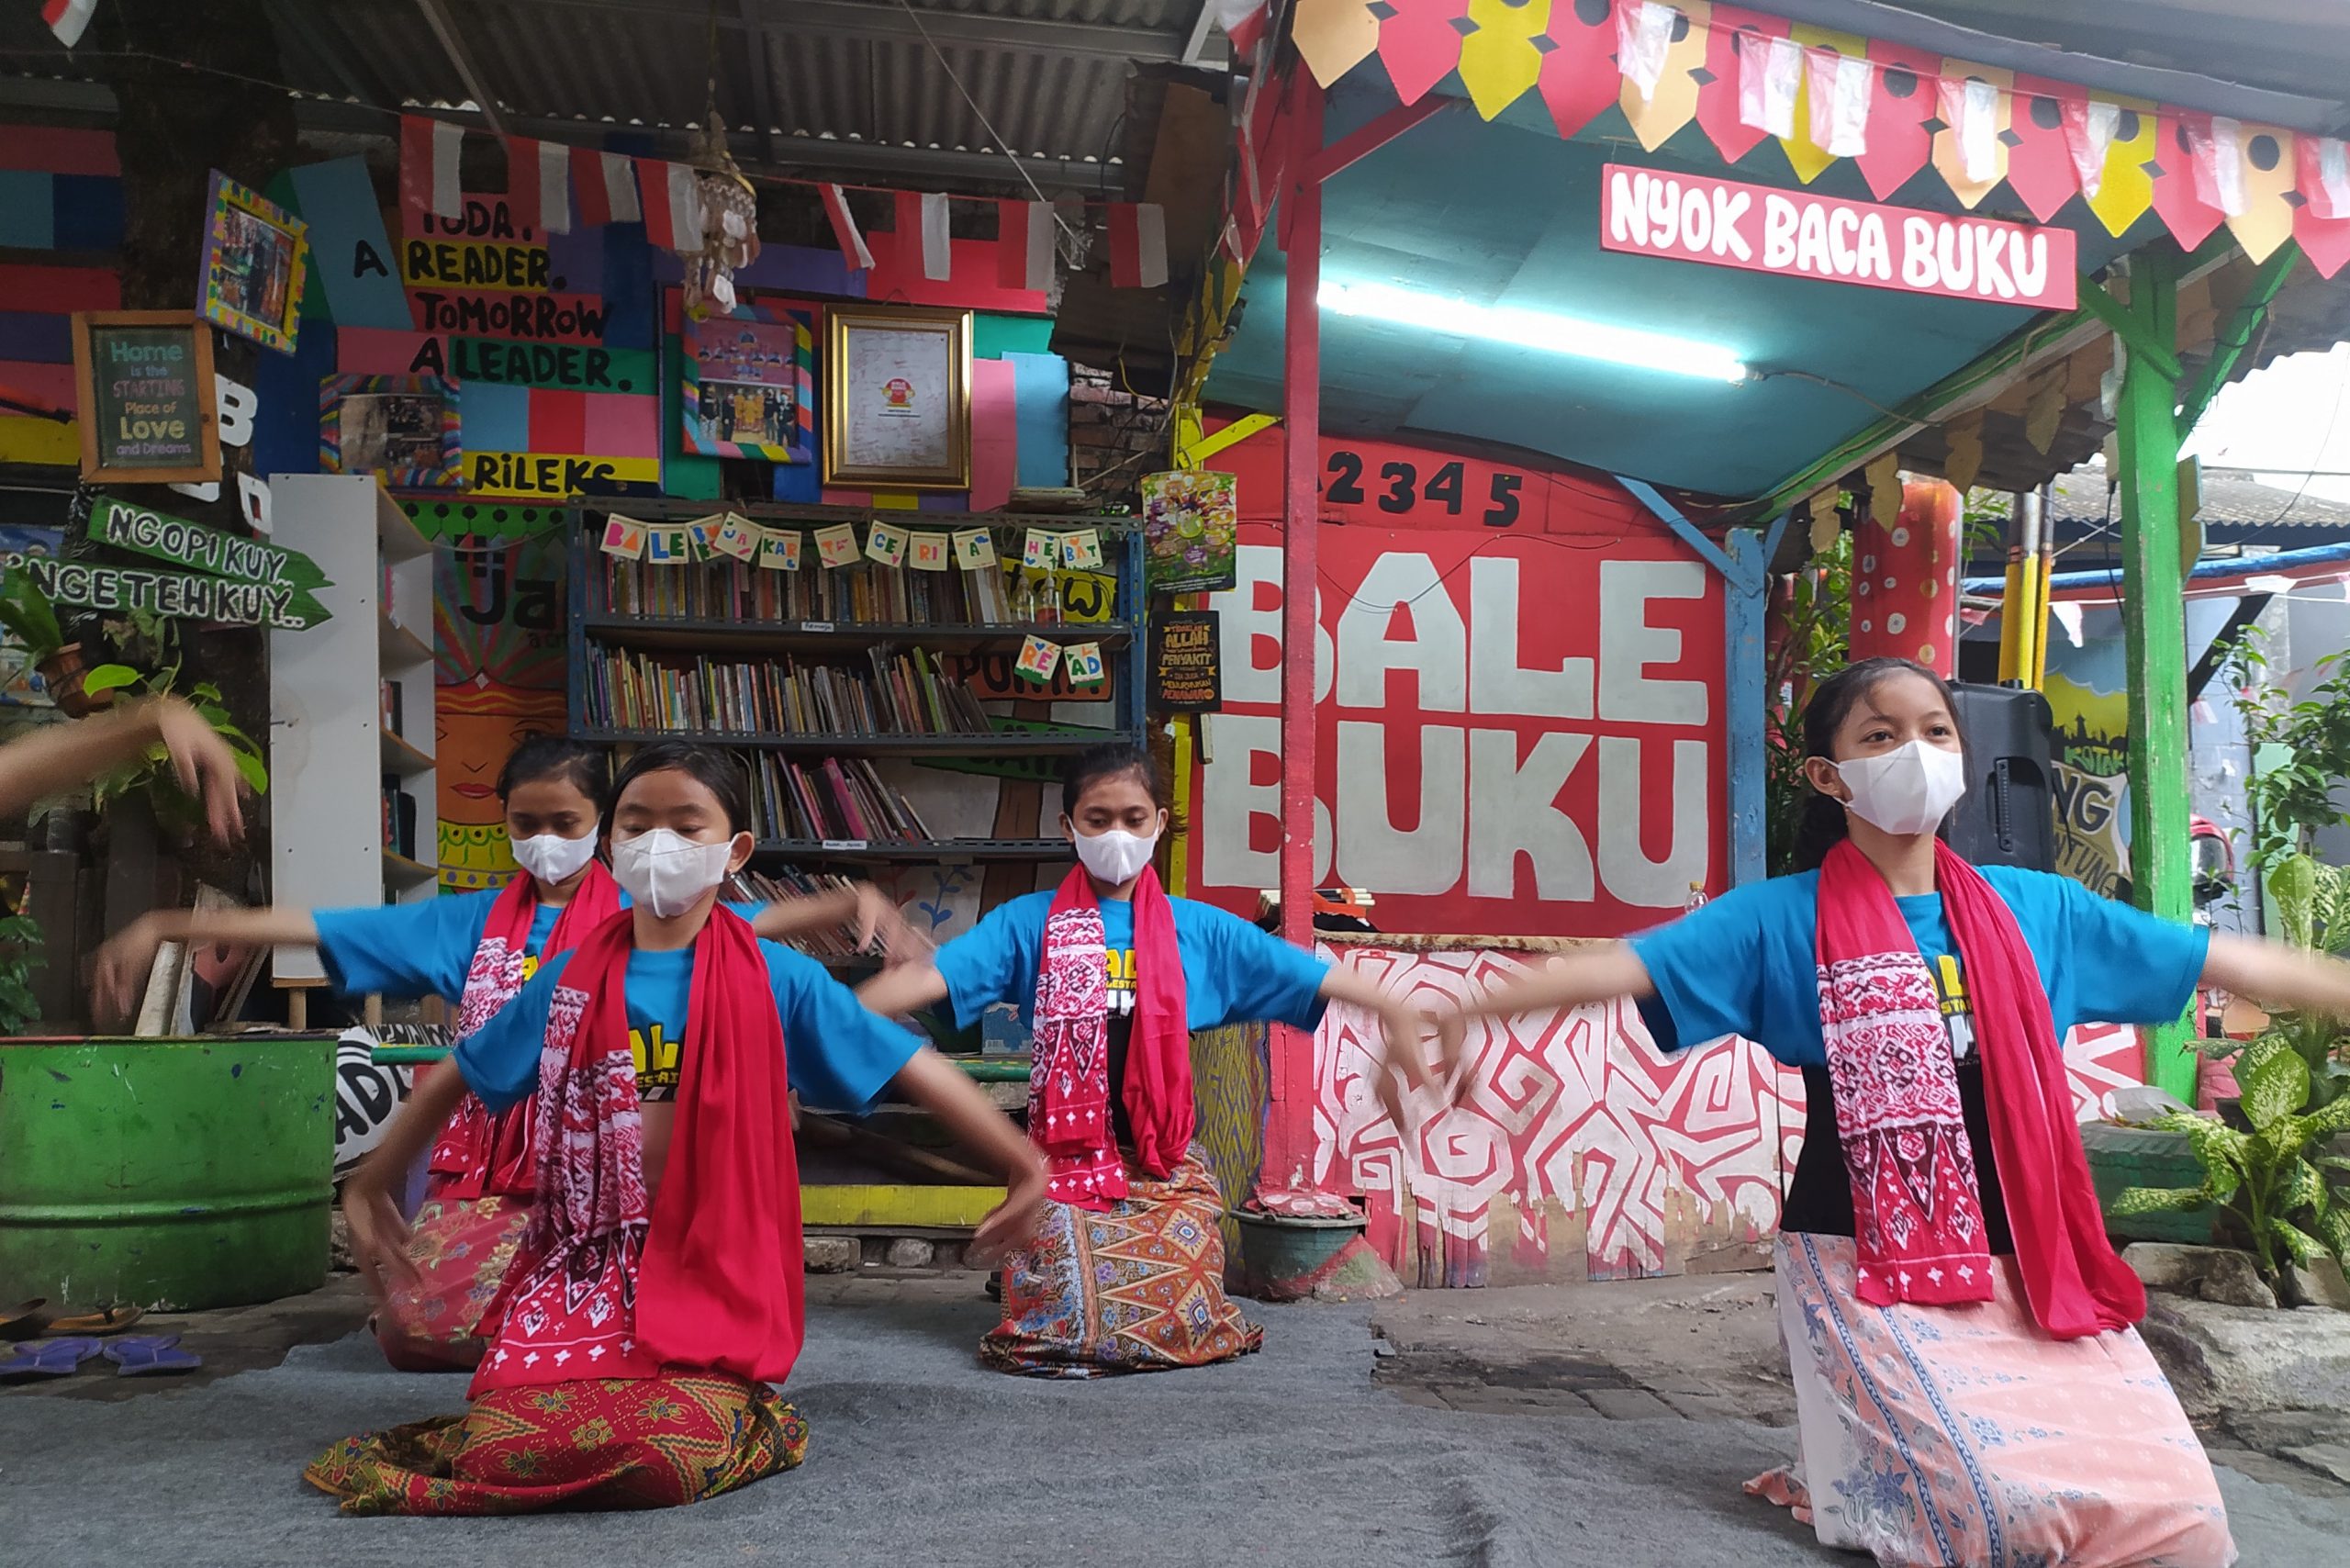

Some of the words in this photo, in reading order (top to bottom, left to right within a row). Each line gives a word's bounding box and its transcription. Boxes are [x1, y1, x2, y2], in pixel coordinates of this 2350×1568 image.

[1610, 172, 1751, 262] NYOK
[1763, 194, 1892, 281] BACA
[1901, 216, 2049, 298] BUKU
[354, 240, 388, 278] A
[408, 240, 567, 290] READER.
[110, 341, 184, 362] Home
[145, 366, 169, 377] the
[409, 338, 444, 376] A
[455, 339, 632, 392] LEADER.
[113, 379, 185, 398] STARTING
[125, 402, 160, 416] Place
[163, 400, 178, 414] of
[119, 416, 185, 441] Love
[116, 443, 140, 456] and
[142, 442, 192, 456] Dreams
[106, 504, 221, 565] NGOPI
[1165, 631, 1209, 647] ALLAH
[1207, 544, 1708, 725] BALE
[1202, 712, 1708, 909] BUKU
